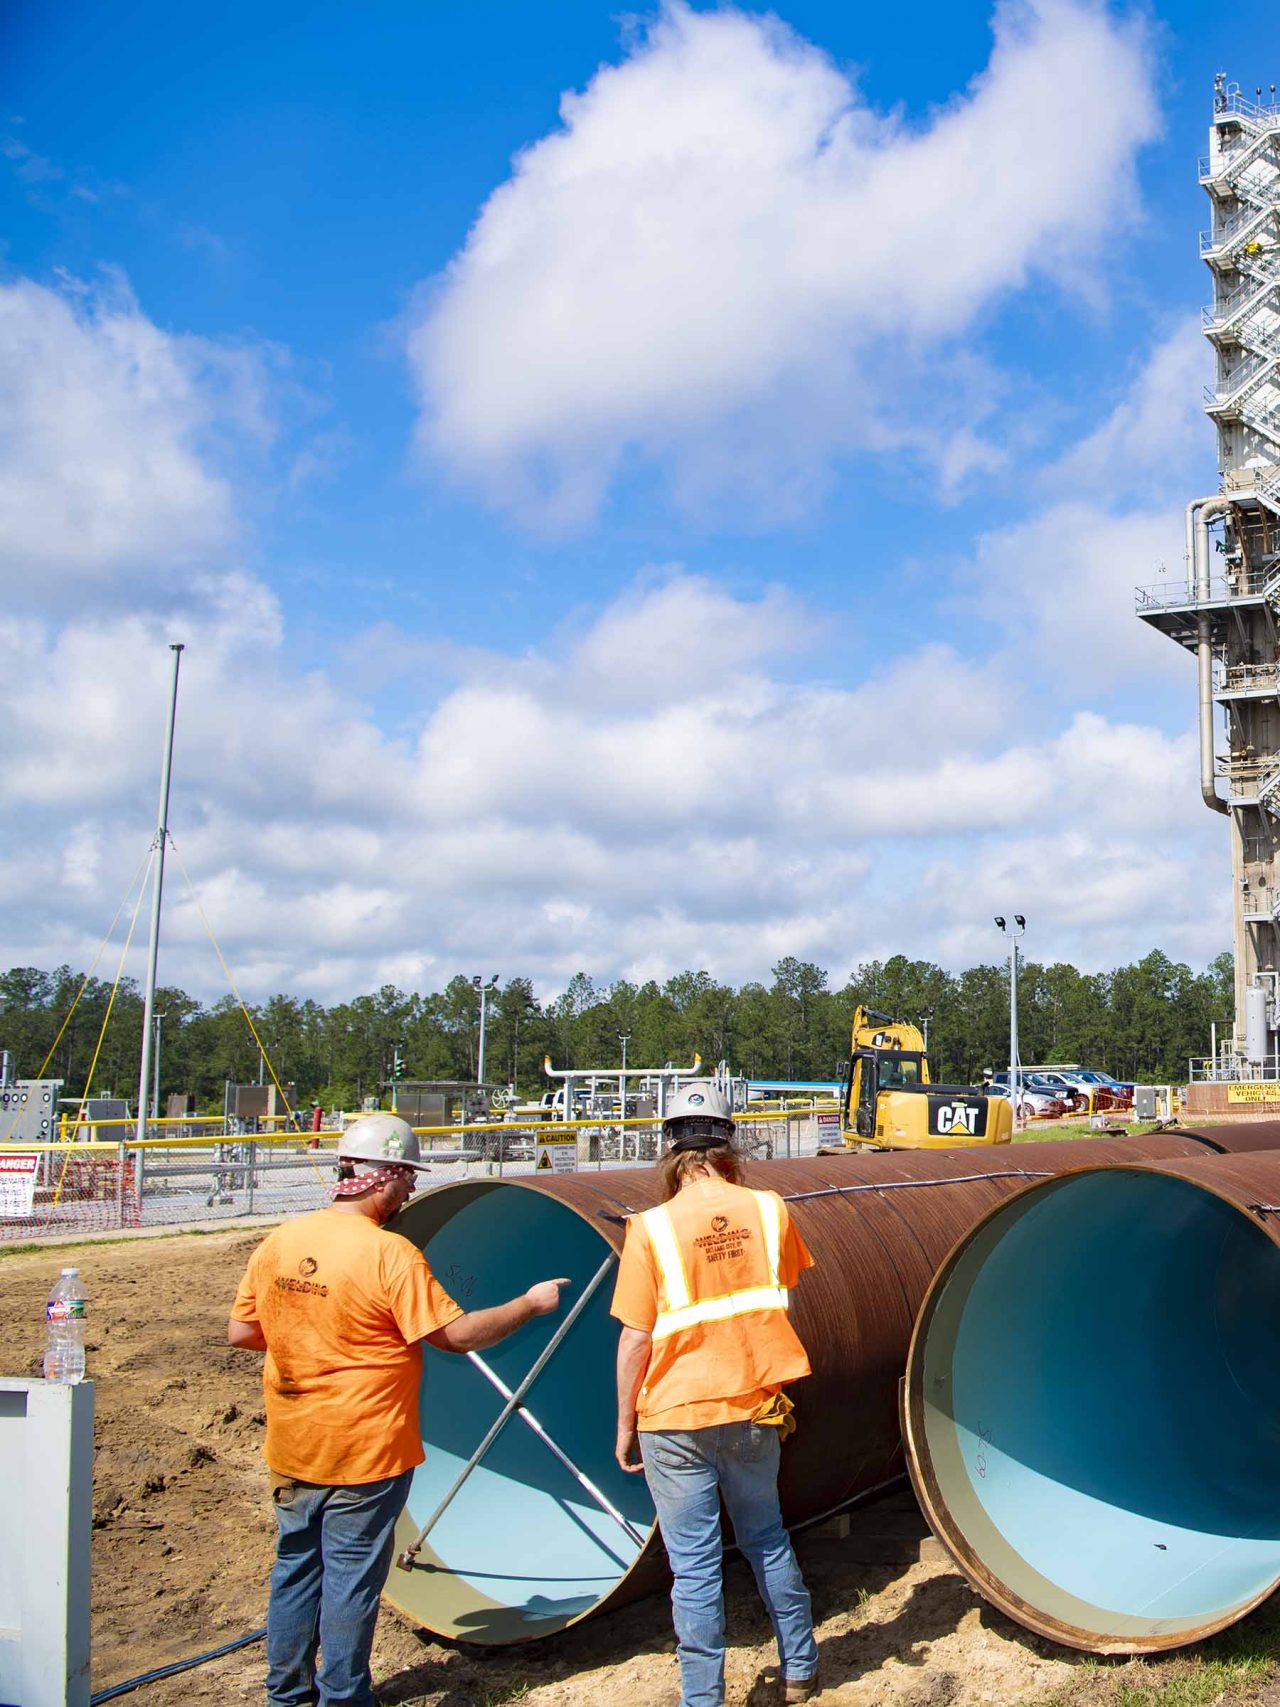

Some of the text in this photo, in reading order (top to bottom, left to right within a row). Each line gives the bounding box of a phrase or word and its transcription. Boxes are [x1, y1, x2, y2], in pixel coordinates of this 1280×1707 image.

[937, 1105, 979, 1134] CAT
[546, 1134, 575, 1143] CAUTION
[695, 1228, 750, 1247] WELDING
[275, 1276, 328, 1297] WELDING
